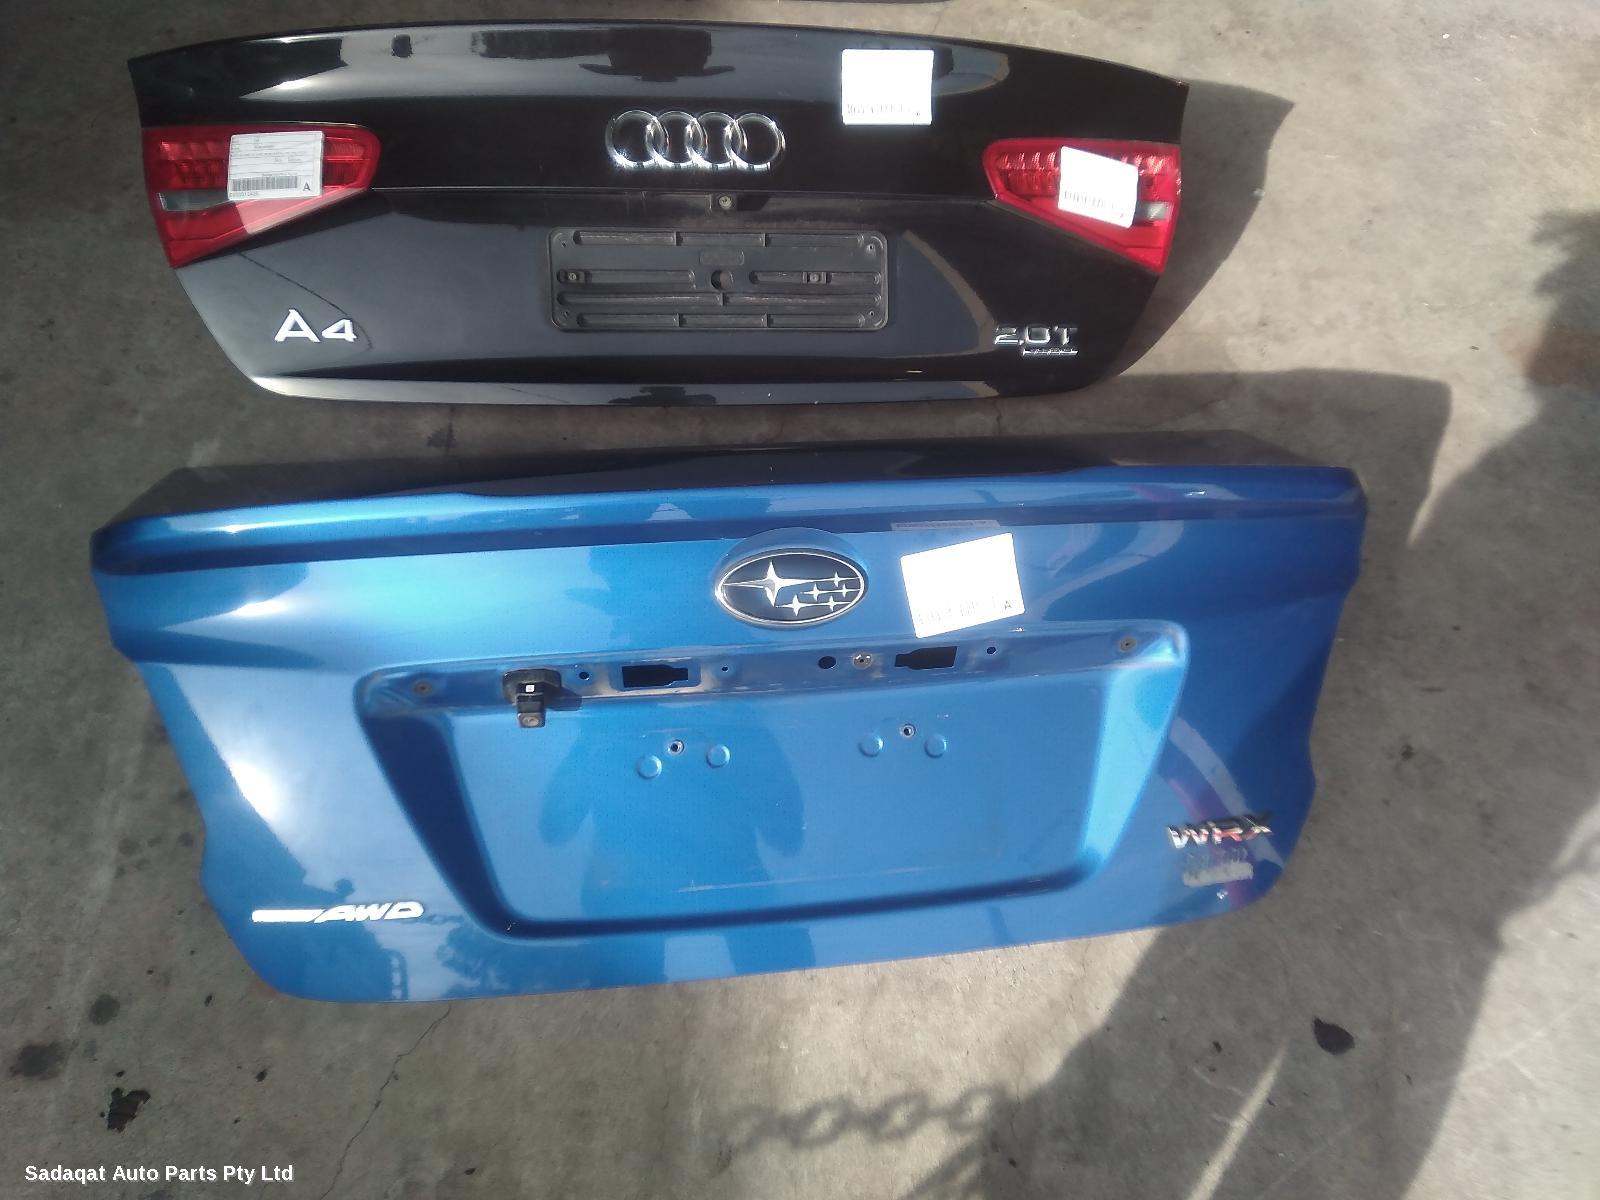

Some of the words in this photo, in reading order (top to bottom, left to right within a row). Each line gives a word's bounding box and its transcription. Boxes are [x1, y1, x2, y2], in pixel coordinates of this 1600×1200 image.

[302, 181, 312, 192] A
[274, 308, 358, 343] A4
[1166, 815, 1273, 850] WRX
[313, 901, 425, 924] AWD
